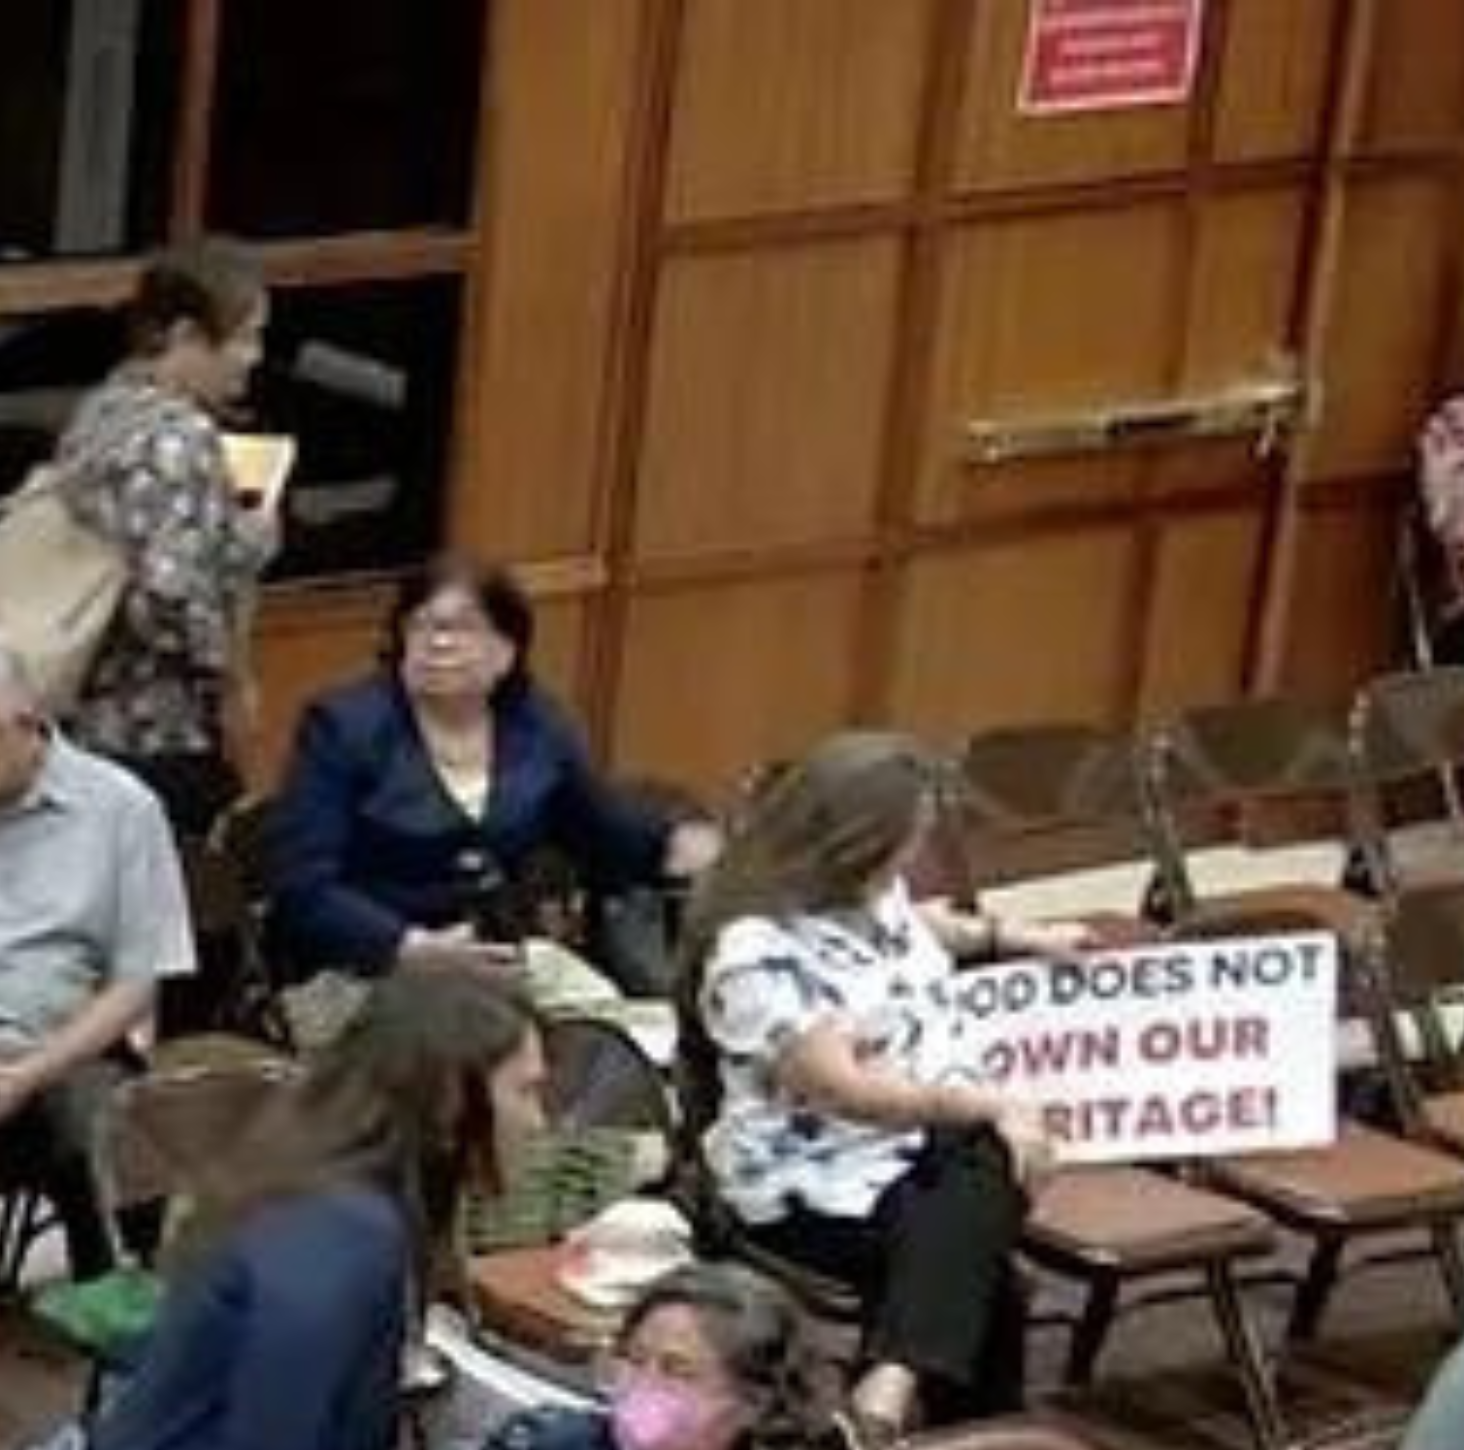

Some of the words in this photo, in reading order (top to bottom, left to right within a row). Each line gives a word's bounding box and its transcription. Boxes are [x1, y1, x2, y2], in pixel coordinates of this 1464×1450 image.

[1050, 955, 1193, 1005] DOES
[1211, 945, 1324, 988] NOT
[981, 1024, 1120, 1083] OWN
[1138, 1016, 1270, 1064] OUR
